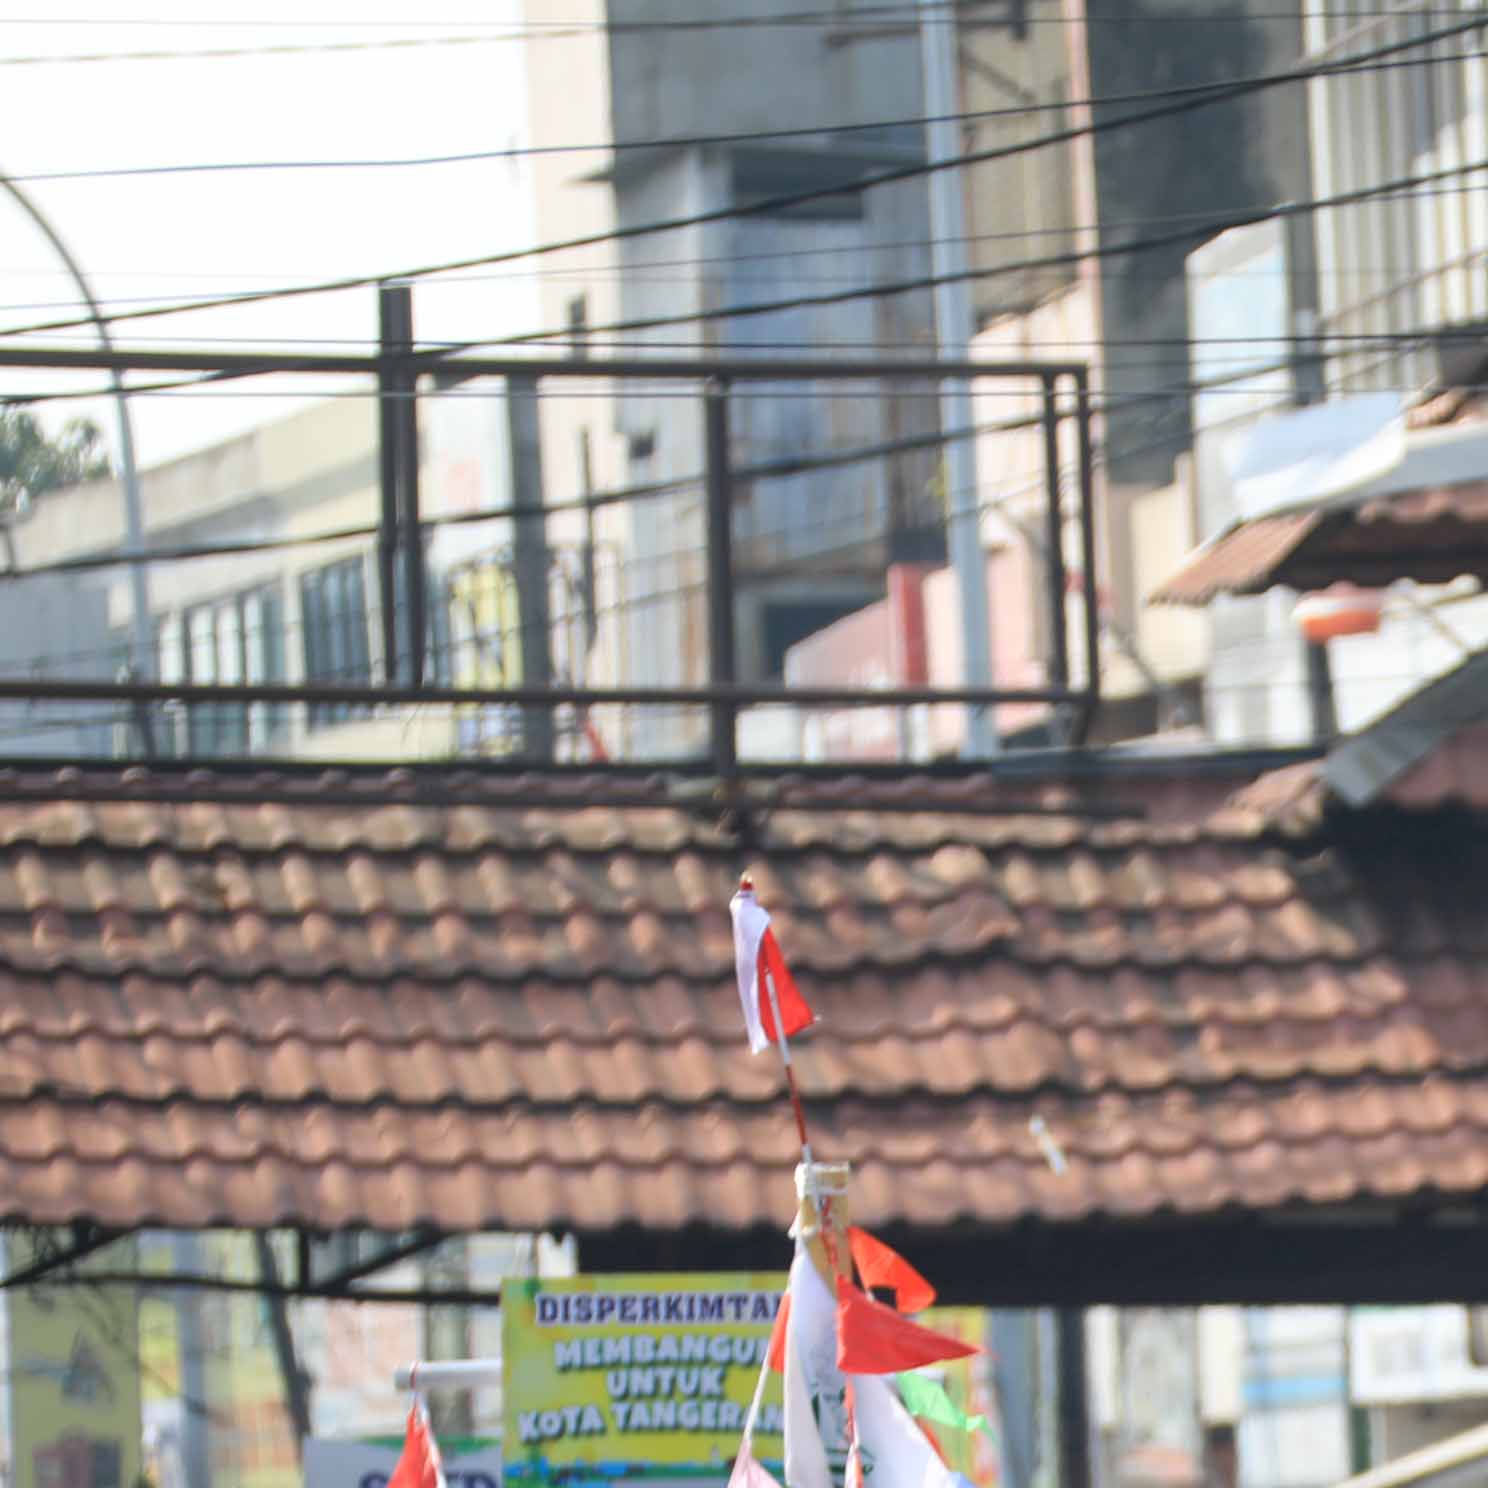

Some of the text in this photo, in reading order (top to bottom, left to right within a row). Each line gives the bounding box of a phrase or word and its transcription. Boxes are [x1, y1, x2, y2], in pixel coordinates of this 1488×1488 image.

[605, 1369, 724, 1400] UNTUK
[519, 1402, 787, 1443] KOTA TANGERAN
